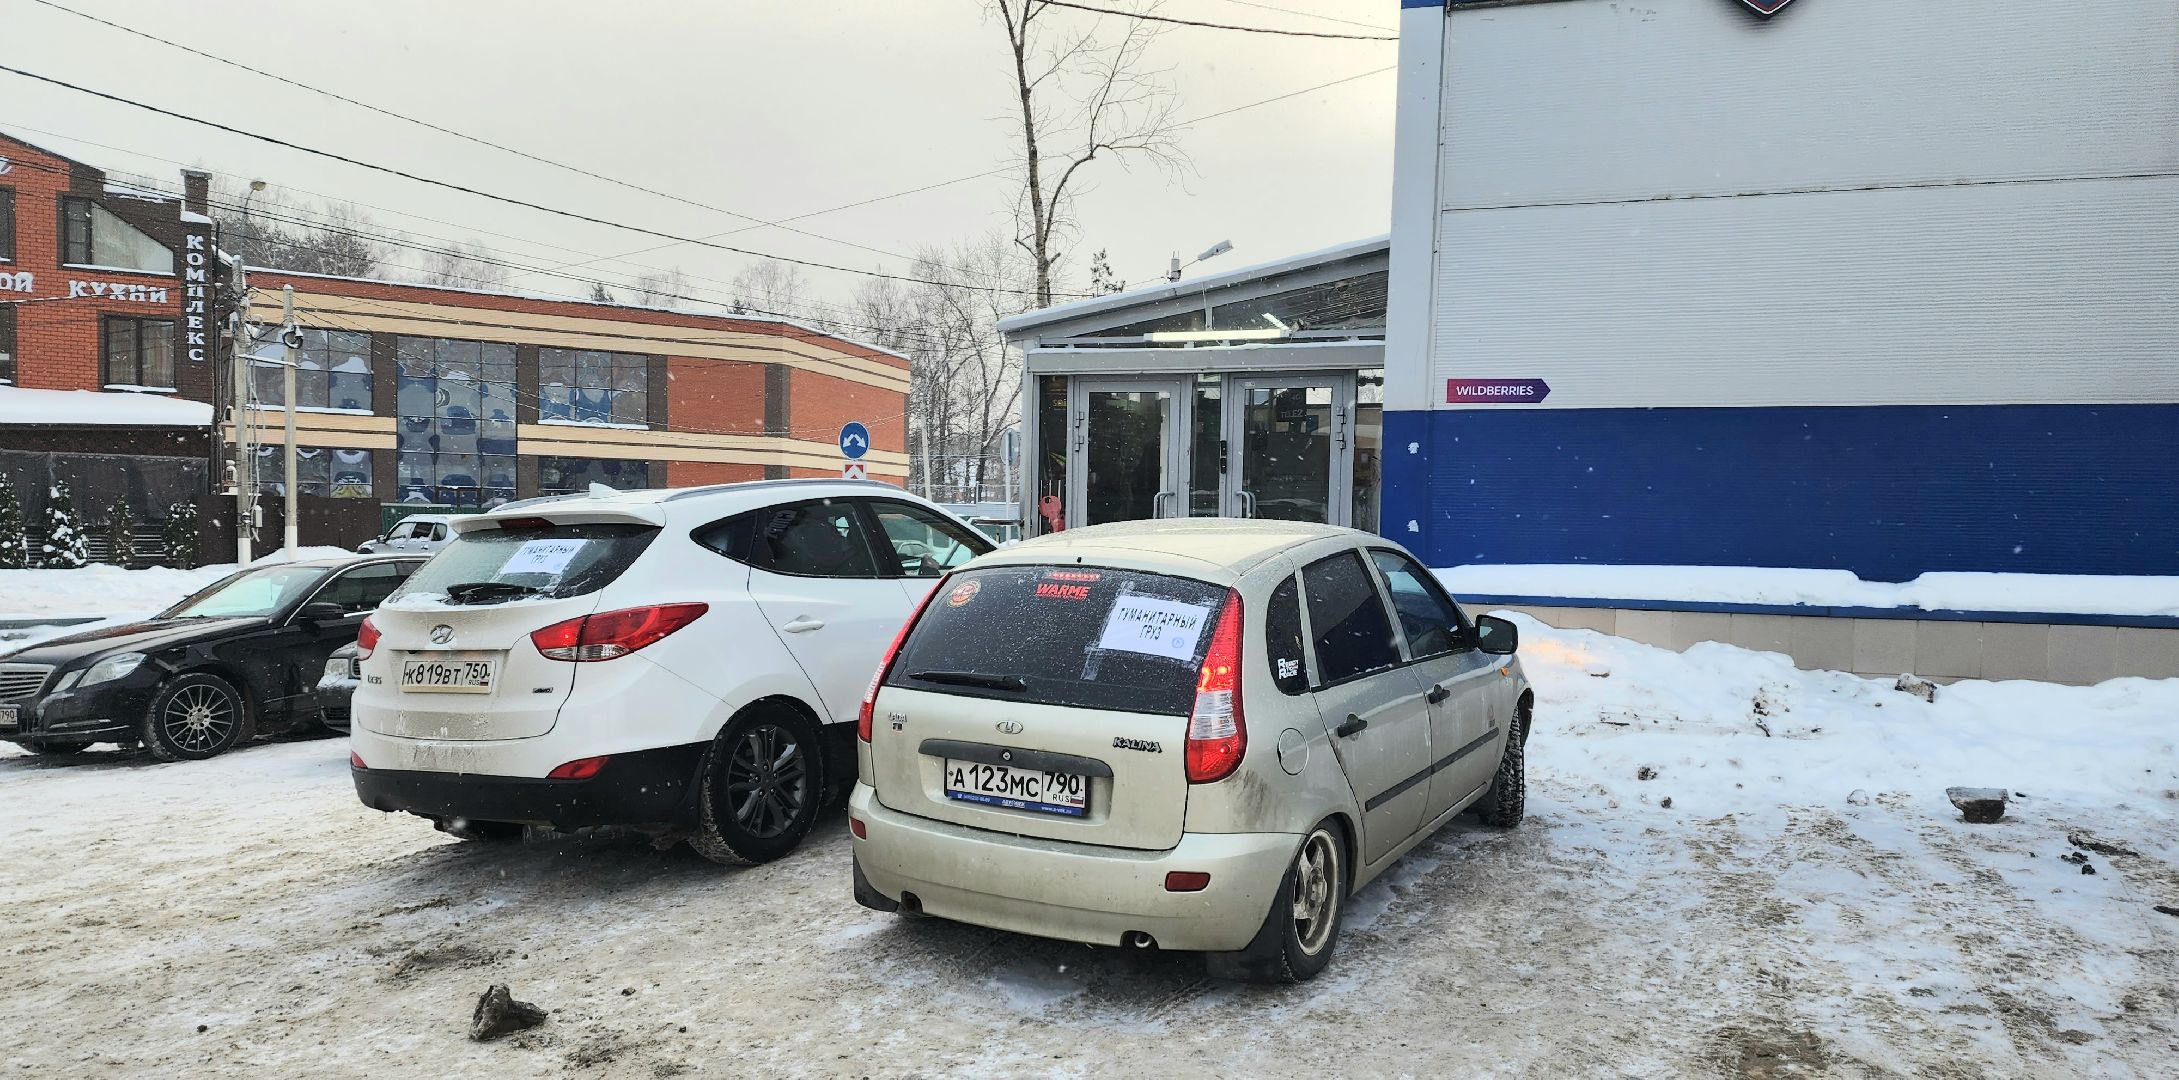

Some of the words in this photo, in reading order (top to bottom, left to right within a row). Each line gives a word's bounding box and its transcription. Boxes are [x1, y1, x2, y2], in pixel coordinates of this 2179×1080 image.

[69, 280, 167, 304] КУХНИ
[186, 234, 205, 361] КОМПЛЕКС
[1456, 385, 1534, 396] WILDBERRIES
[1037, 583, 1091, 599] WARME
[1117, 607, 1198, 630] ГУМАНИТАРНЫЙ
[1139, 624, 1162, 640] ГРУЗ
[465, 662, 490, 679] 750
[0, 711, 14, 719] 790
[1112, 736, 1162, 753] KALINA
[953, 764, 1039, 797] А123МС
[1044, 771, 1080, 795] 790
[1052, 793, 1070, 803] RUS
